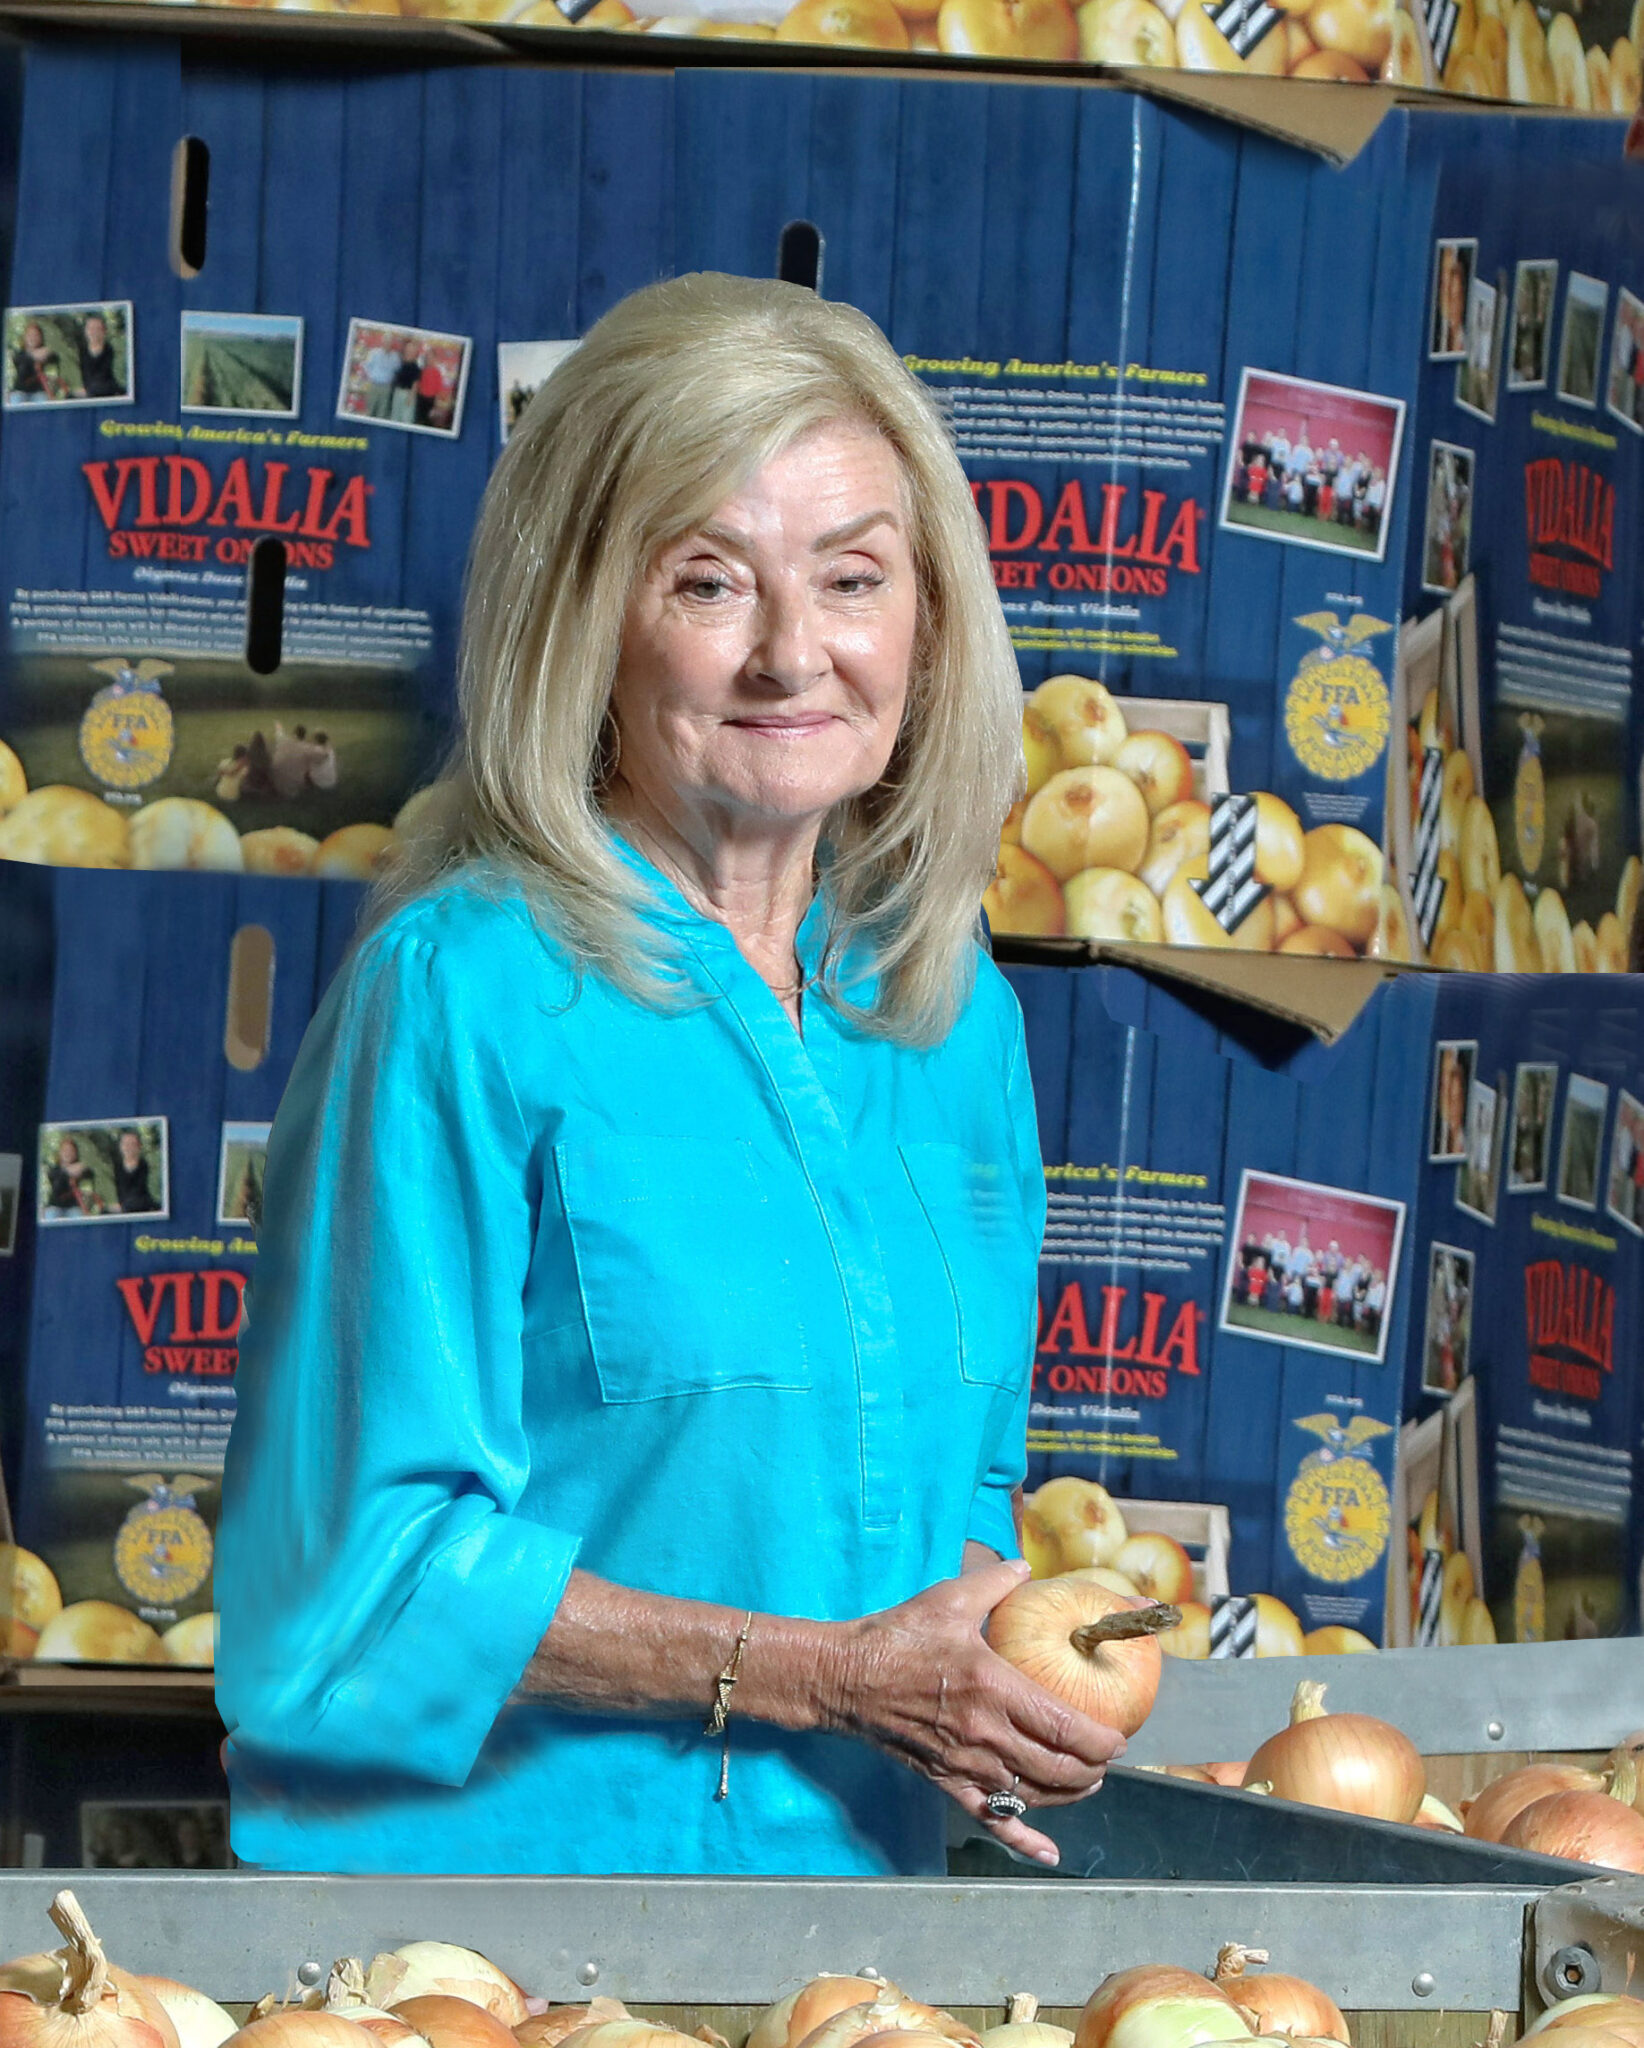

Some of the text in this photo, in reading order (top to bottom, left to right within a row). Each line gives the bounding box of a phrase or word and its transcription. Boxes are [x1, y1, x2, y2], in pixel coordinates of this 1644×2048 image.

[1003, 358, 1119, 378] America's
[1124, 363, 1207, 386] Farmers
[187, 425, 282, 444] America's
[286, 430, 368, 449] Farmers
[82, 455, 370, 547] VIDALIA
[109, 531, 210, 561] SWEET
[1049, 563, 1168, 595] ONIONS
[1321, 684, 1360, 704] FFA
[114, 714, 148, 729] FFA
[1125, 1165, 1207, 1188] Farmers
[135, 1235, 224, 1256] Growing
[144, 1346, 238, 1375] SWEE
[1048, 1364, 1168, 1398] ONIONS
[1321, 1486, 1360, 1506] FFA
[148, 1529, 182, 1544] FFA
